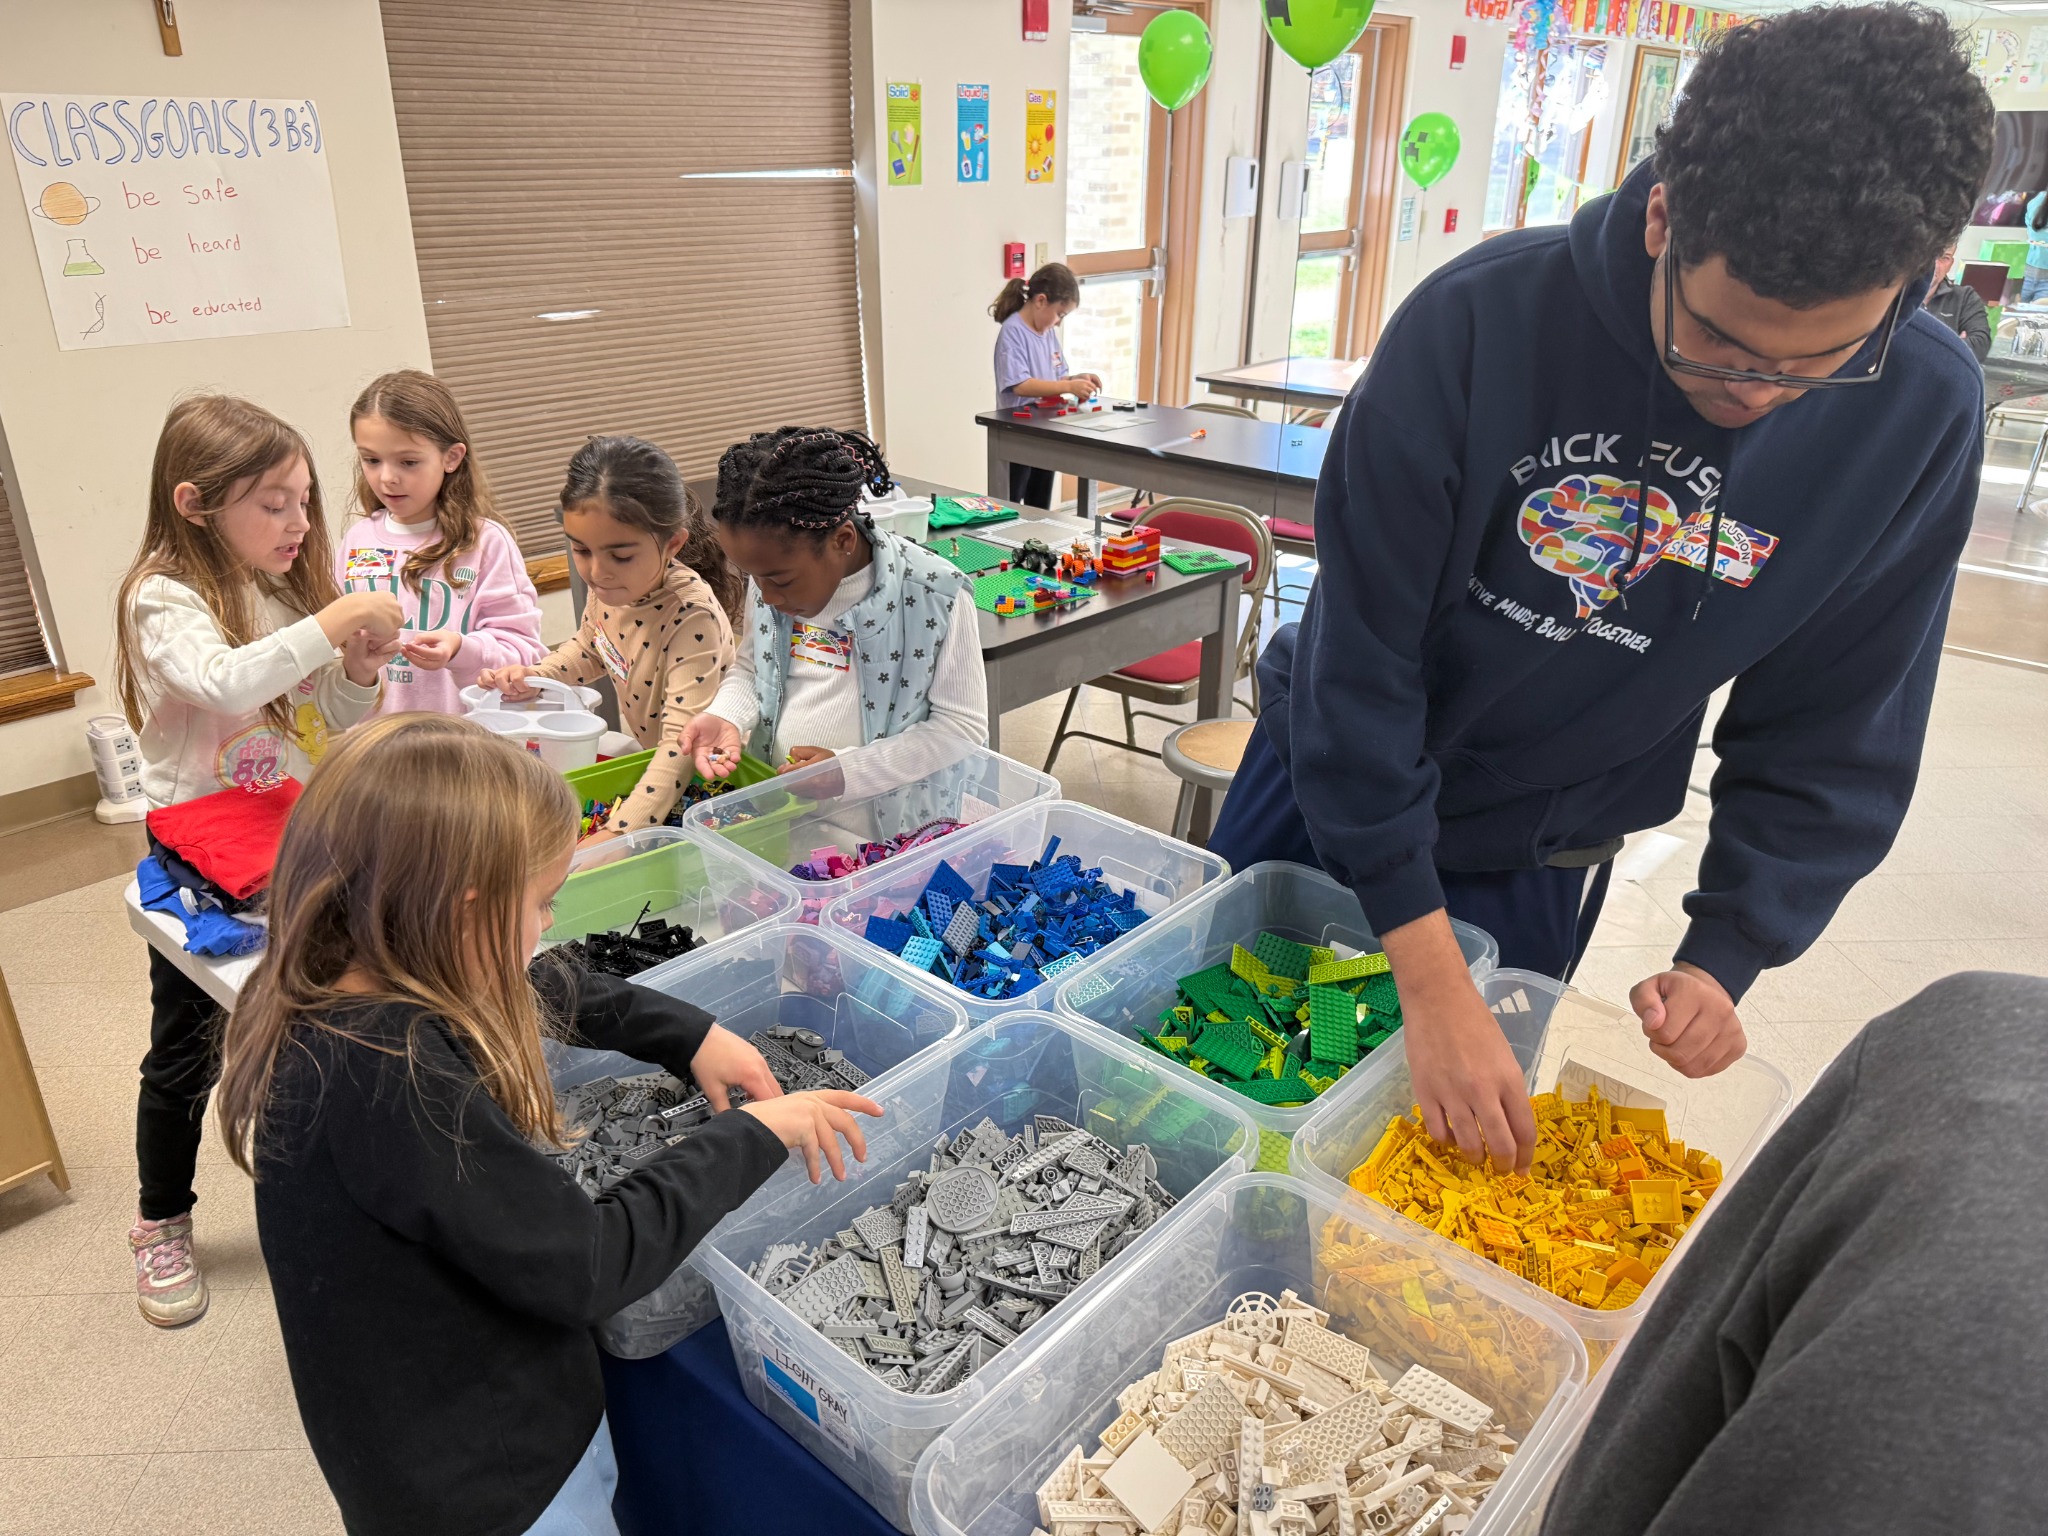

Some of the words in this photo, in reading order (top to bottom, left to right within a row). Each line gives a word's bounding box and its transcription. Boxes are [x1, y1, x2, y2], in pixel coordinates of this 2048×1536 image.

[889, 85, 909, 98] Solid
[958, 86, 982, 101] Liquid
[1028, 92, 1042, 103] Gas
[122, 181, 161, 210] be
[132, 237, 163, 265] be
[188, 233, 241, 254] heard
[145, 302, 178, 325] be
[192, 297, 262, 317] educated
[1683, 520, 1712, 539] BRIC
[1720, 522, 1751, 562] FUSION
[800, 630, 818, 645] BRICK
[820, 631, 843, 654] FUSION
[232, 755, 278, 786] 82
[775, 1348, 816, 1391] LIGHT
[818, 1387, 848, 1424] GRAY
